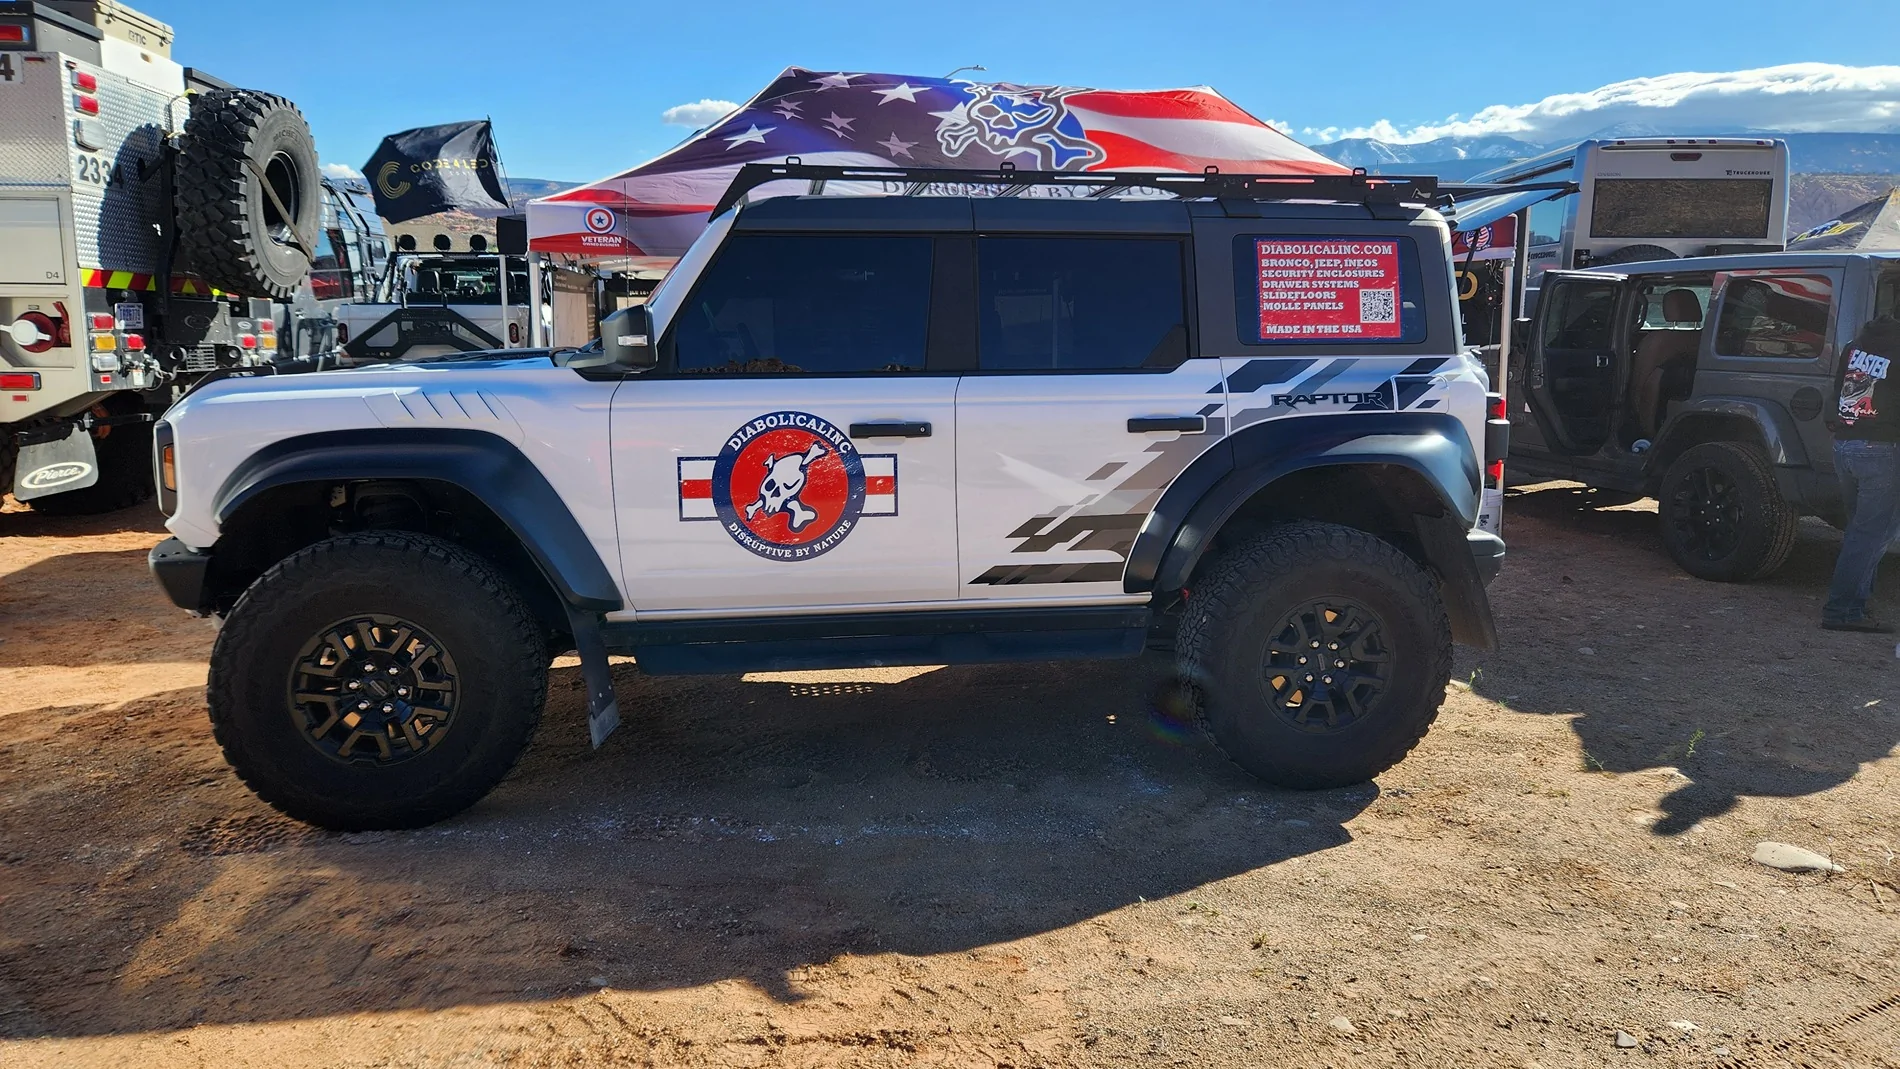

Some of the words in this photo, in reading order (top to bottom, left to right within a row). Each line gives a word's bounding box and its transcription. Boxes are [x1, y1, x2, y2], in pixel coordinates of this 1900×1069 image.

[1046, 186, 1079, 199] BY
[581, 236, 622, 244] VETERAN
[1261, 244, 1393, 255] DIABOLICALINC.COM
[1261, 258, 1313, 269] BRONCO,
[1314, 258, 1343, 269] JEEP,
[1344, 258, 1378, 267] INEOS
[46, 271, 59, 279] D4
[1262, 270, 1314, 278] SECURITY
[1316, 270, 1385, 278] ENCLOSURES
[1262, 280, 1310, 289] DRAWER
[1311, 280, 1360, 289] SYSTEMS
[1262, 291, 1337, 300] SLIDEFLOORS
[1263, 302, 1301, 311] MOLLE
[1303, 302, 1344, 310] PANELS
[1266, 325, 1300, 334] MADE
[1302, 325, 1316, 334] IN
[1316, 325, 1340, 334] THE
[1341, 325, 1363, 334] USA
[1847, 349, 1891, 380] EASTER
[1271, 392, 1389, 410] RAPTOR
[728, 413, 852, 455] DIABOLICALINC
[33, 467, 78, 485] Pierce
[728, 522, 792, 558] DISRUPTIVE
[795, 547, 811, 558] BY
[813, 519, 852, 553] NATURE
